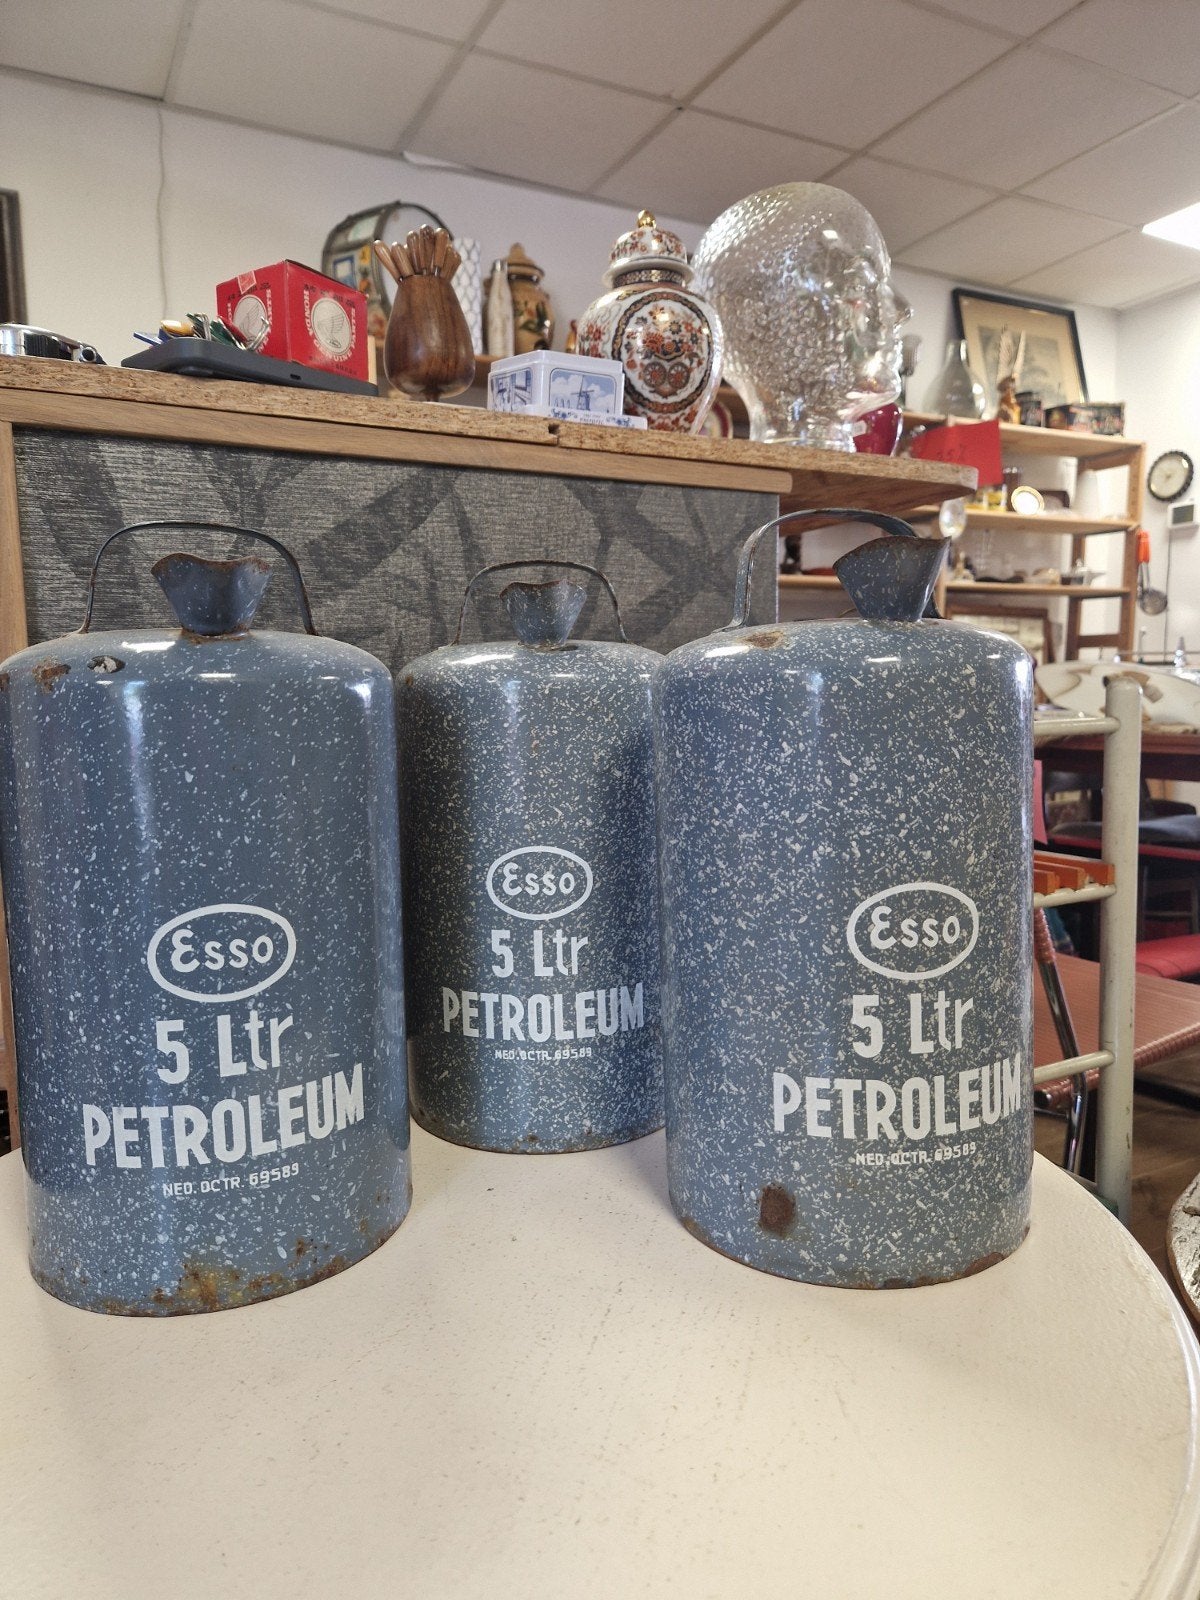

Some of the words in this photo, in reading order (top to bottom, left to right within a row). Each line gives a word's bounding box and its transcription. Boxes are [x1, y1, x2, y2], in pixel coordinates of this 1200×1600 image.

[303, 289, 314, 336] HONDA
[502, 862, 575, 896] Esso
[170, 928, 274, 973] Esso
[869, 904, 961, 949] Esso
[491, 929, 514, 978] 5
[533, 928, 588, 977] Ltr
[442, 982, 645, 1043] PETROLEUM
[851, 994, 884, 1058] 5
[909, 990, 974, 1055] Ltr
[155, 1018, 190, 1085] 5
[216, 1009, 294, 1078] Ltr
[82, 1062, 365, 1169] PETROLEUM
[772, 1052, 1021, 1141] PETROLEUM
[249, 1162, 300, 1186] 69589
